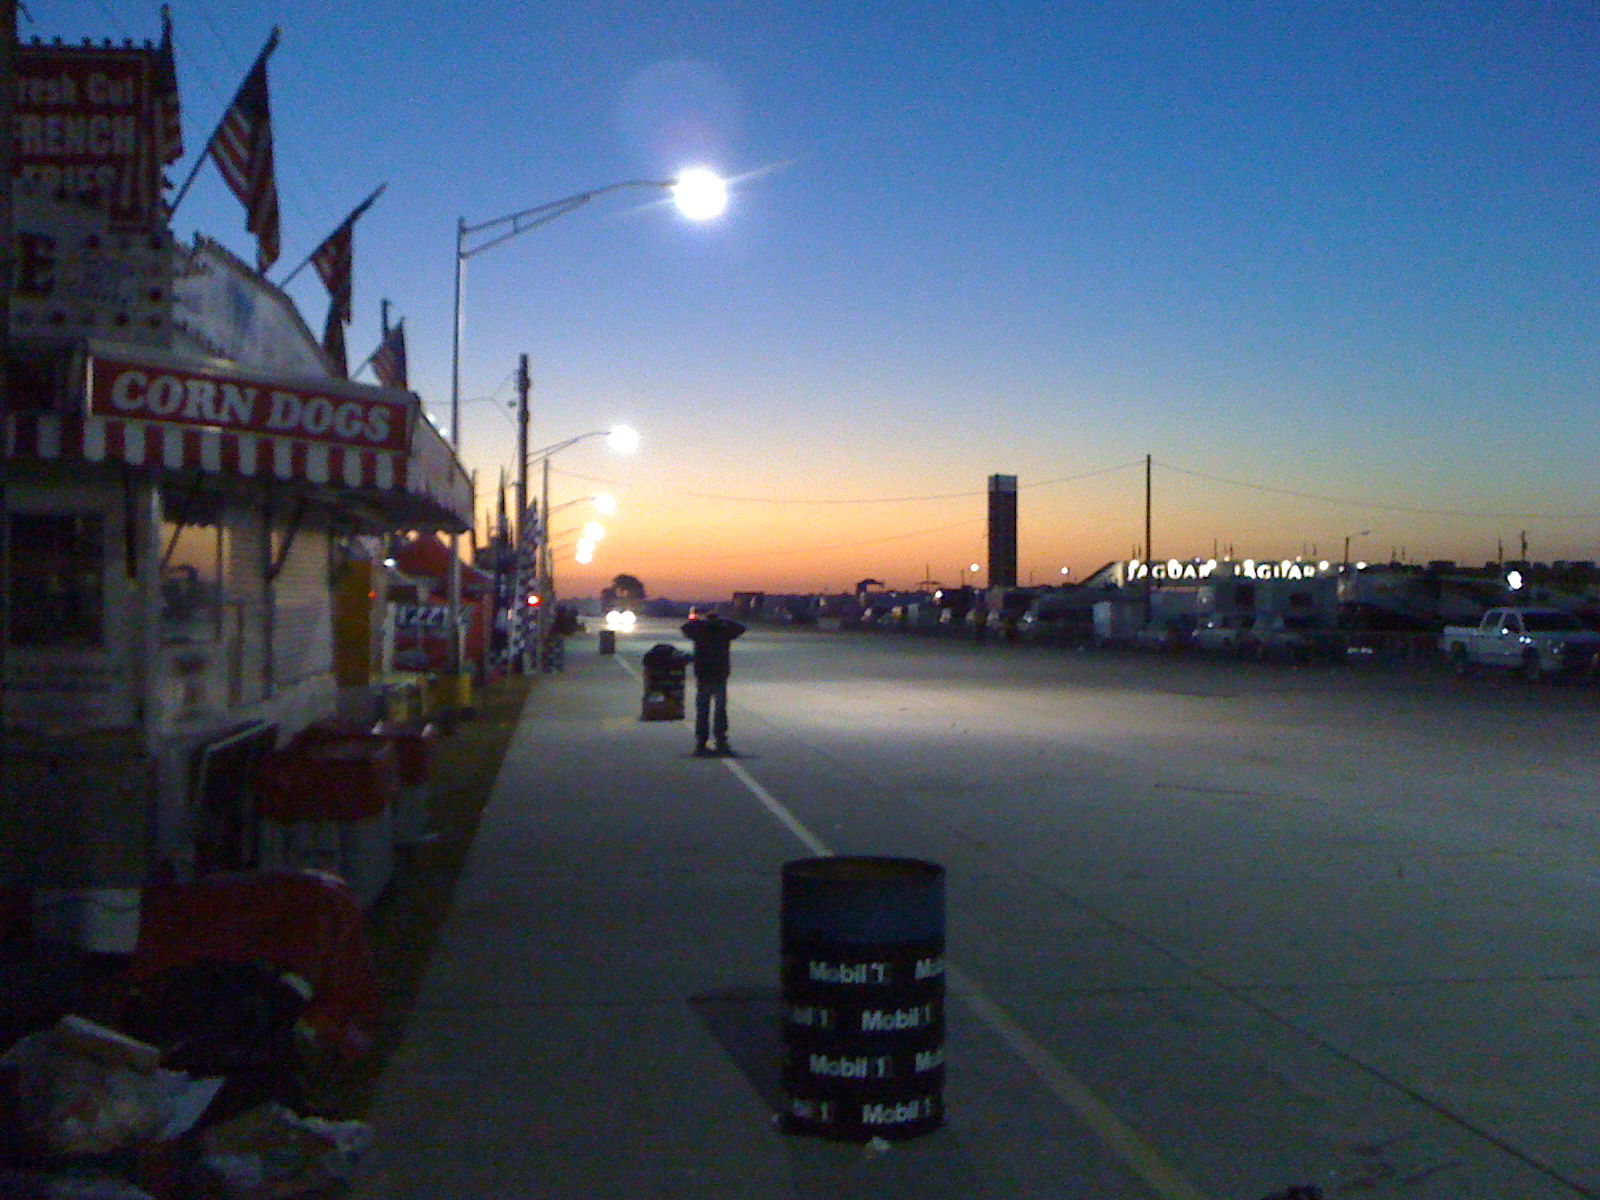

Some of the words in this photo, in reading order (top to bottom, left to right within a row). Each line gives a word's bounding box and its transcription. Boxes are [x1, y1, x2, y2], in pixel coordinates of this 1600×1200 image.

[111, 369, 257, 426] CORN
[268, 391, 391, 442] DOGS
[809, 960, 867, 984] Mobil
[862, 1007, 918, 1031] Mobil
[809, 1053, 867, 1078] Mobil
[862, 1100, 918, 1125] Mobil
